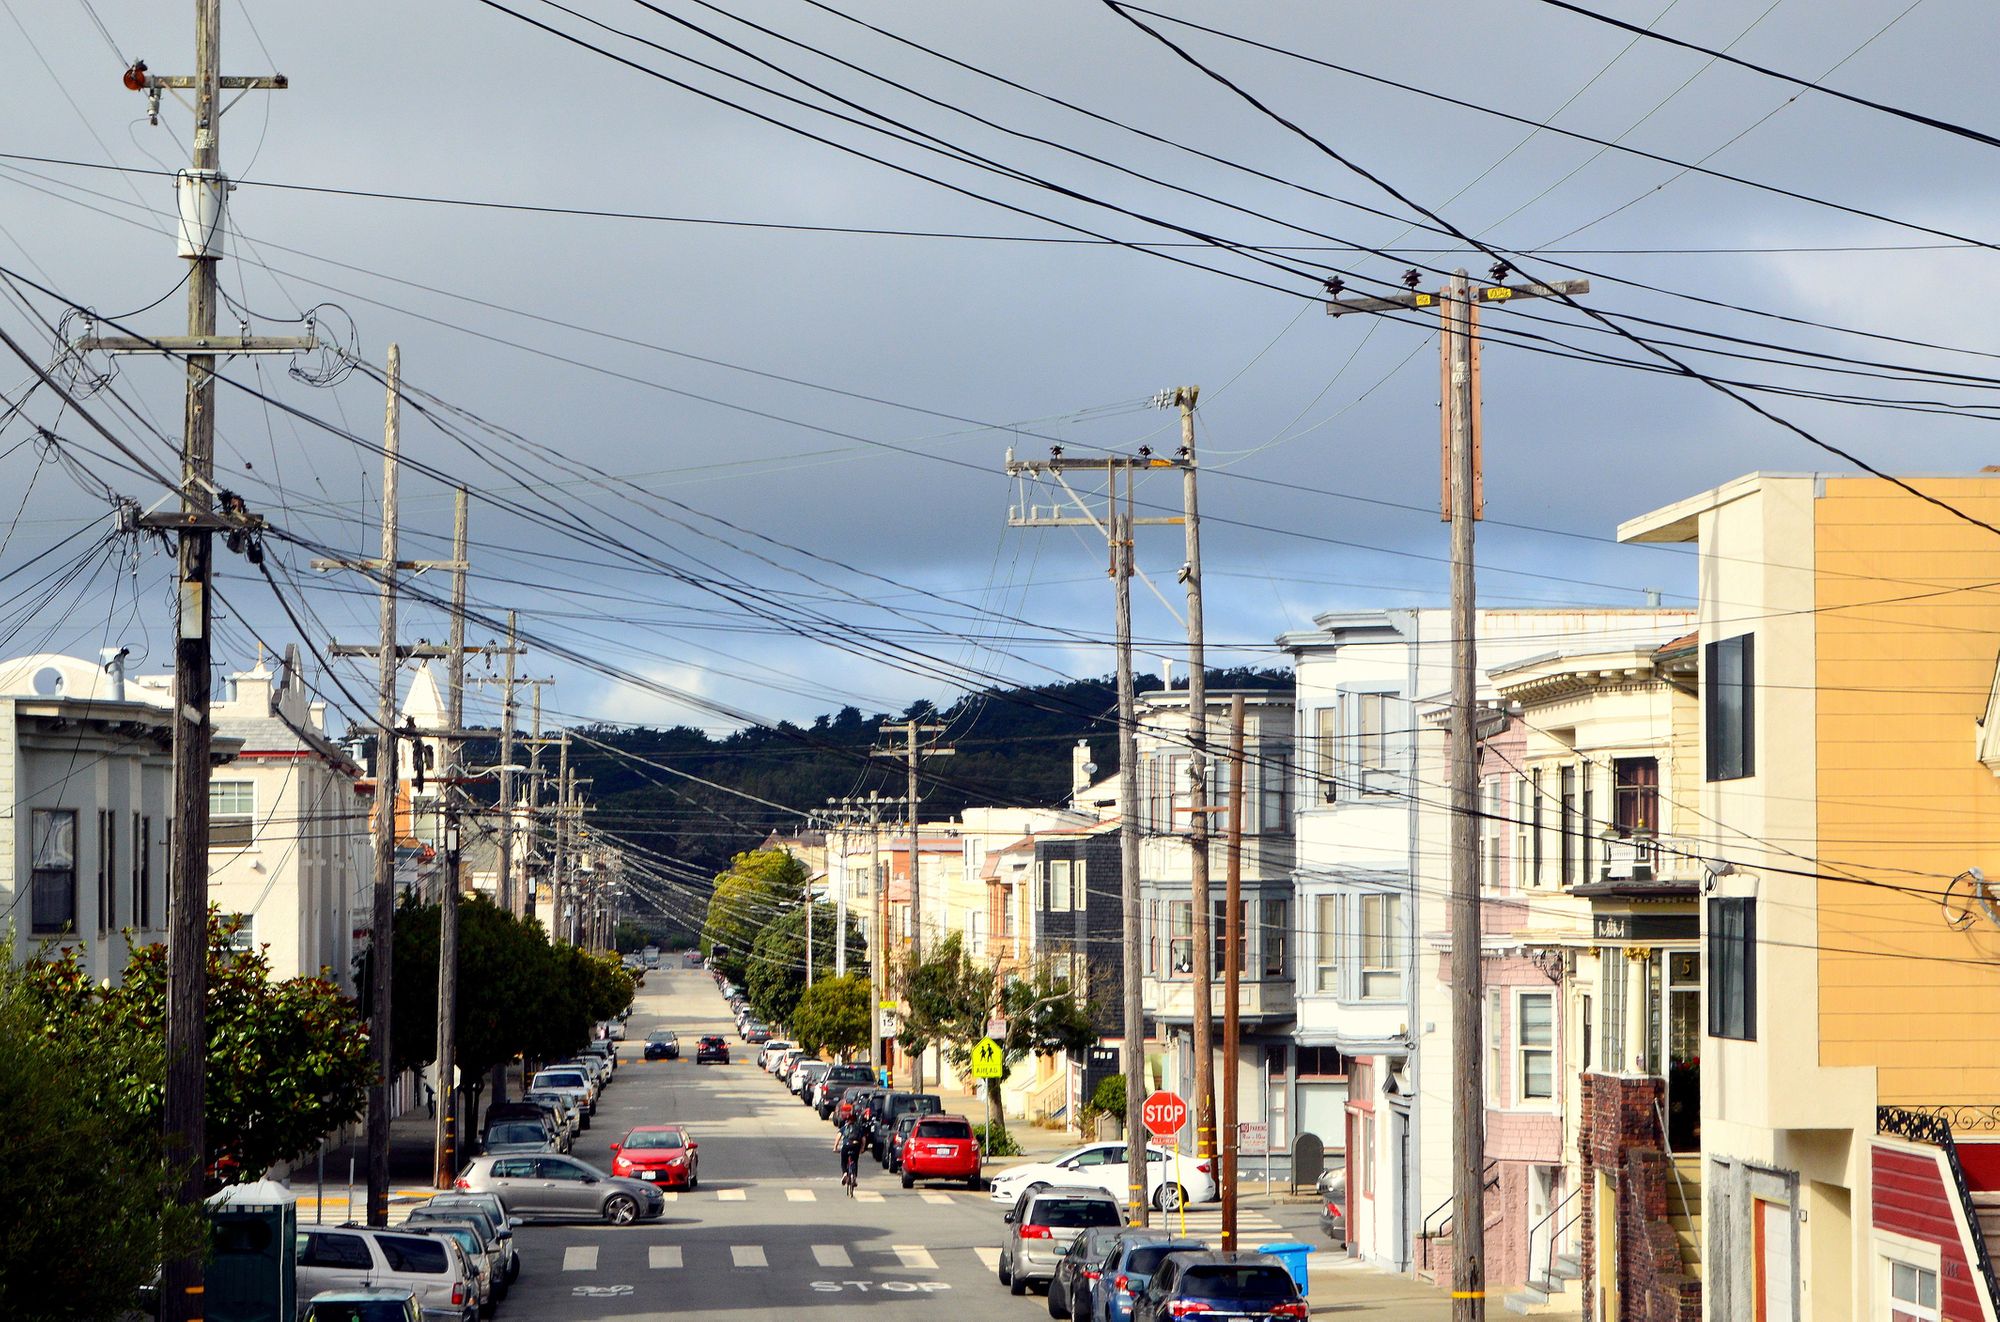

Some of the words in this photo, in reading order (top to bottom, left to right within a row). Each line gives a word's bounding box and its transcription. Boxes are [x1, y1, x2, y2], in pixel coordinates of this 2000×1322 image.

[883, 1019, 894, 1027] 15
[1146, 1104, 1184, 1123] STOP
[809, 1281, 953, 1292] STOP
